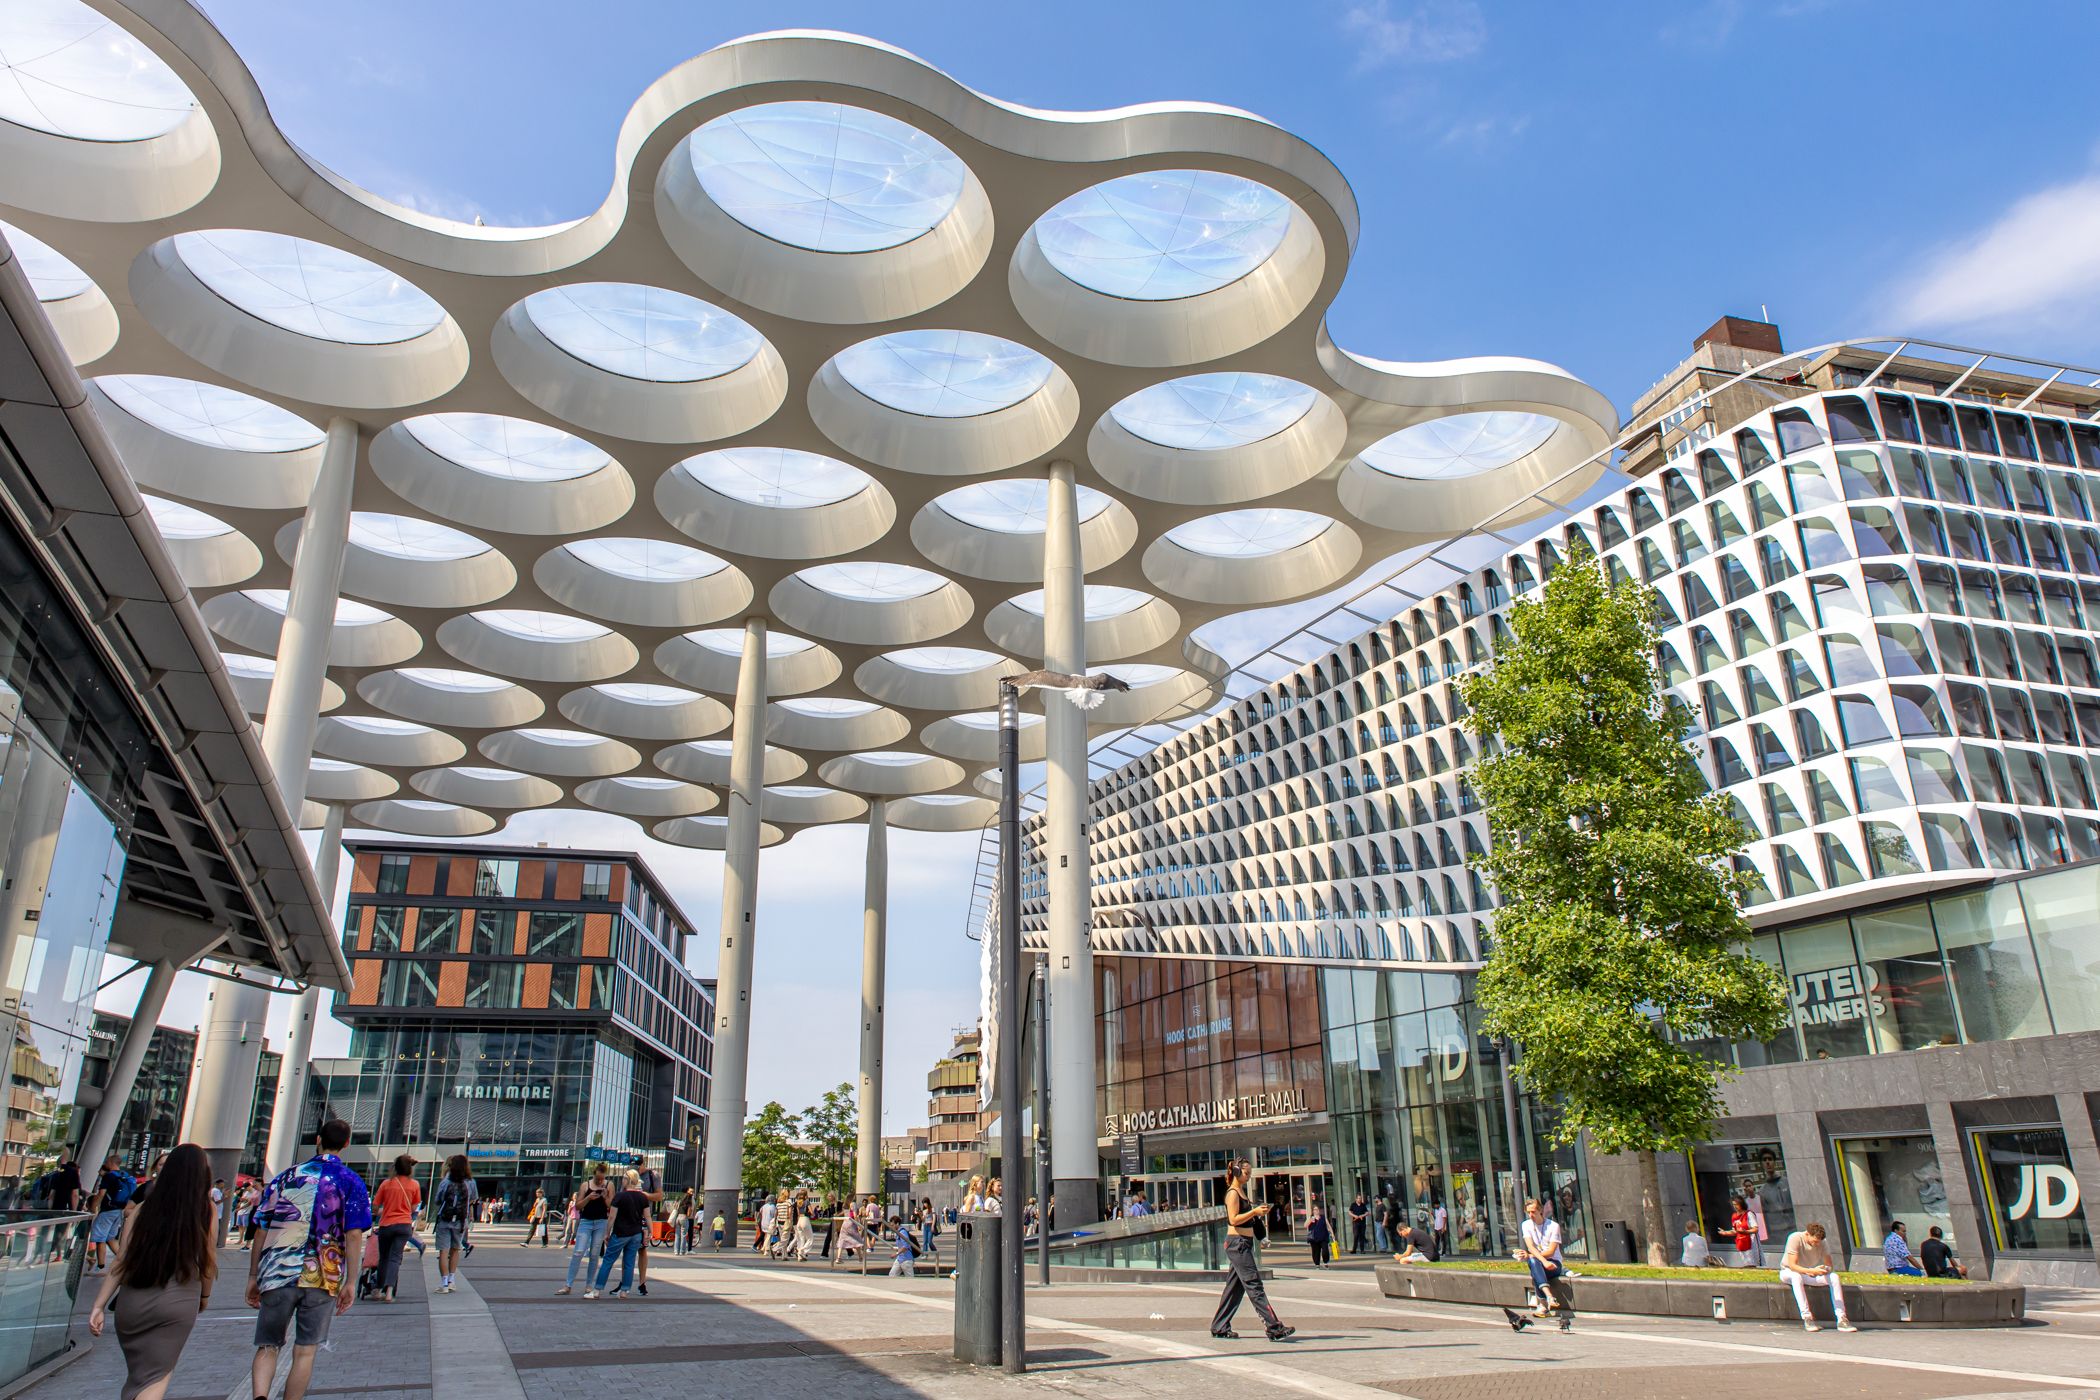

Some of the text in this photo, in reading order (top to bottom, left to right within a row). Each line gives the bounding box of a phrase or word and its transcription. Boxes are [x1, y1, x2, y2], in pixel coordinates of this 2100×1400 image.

[1792, 965, 1879, 1005] UTED
[1784, 995, 1886, 1029] AINERS
[88, 1029, 117, 1042] ATHARIJNE
[1166, 1028, 1185, 1045] HOOG
[1197, 1043, 1208, 1052] MAL
[454, 1085, 551, 1099] TRAIN MORE
[1123, 1089, 1308, 1133] HOOG CATHARIJNE THE MALL
[138, 1133, 151, 1169] FIVE GUYS
[525, 1149, 569, 1157] TRAINMORE
[2008, 1164, 2080, 1221] JD
